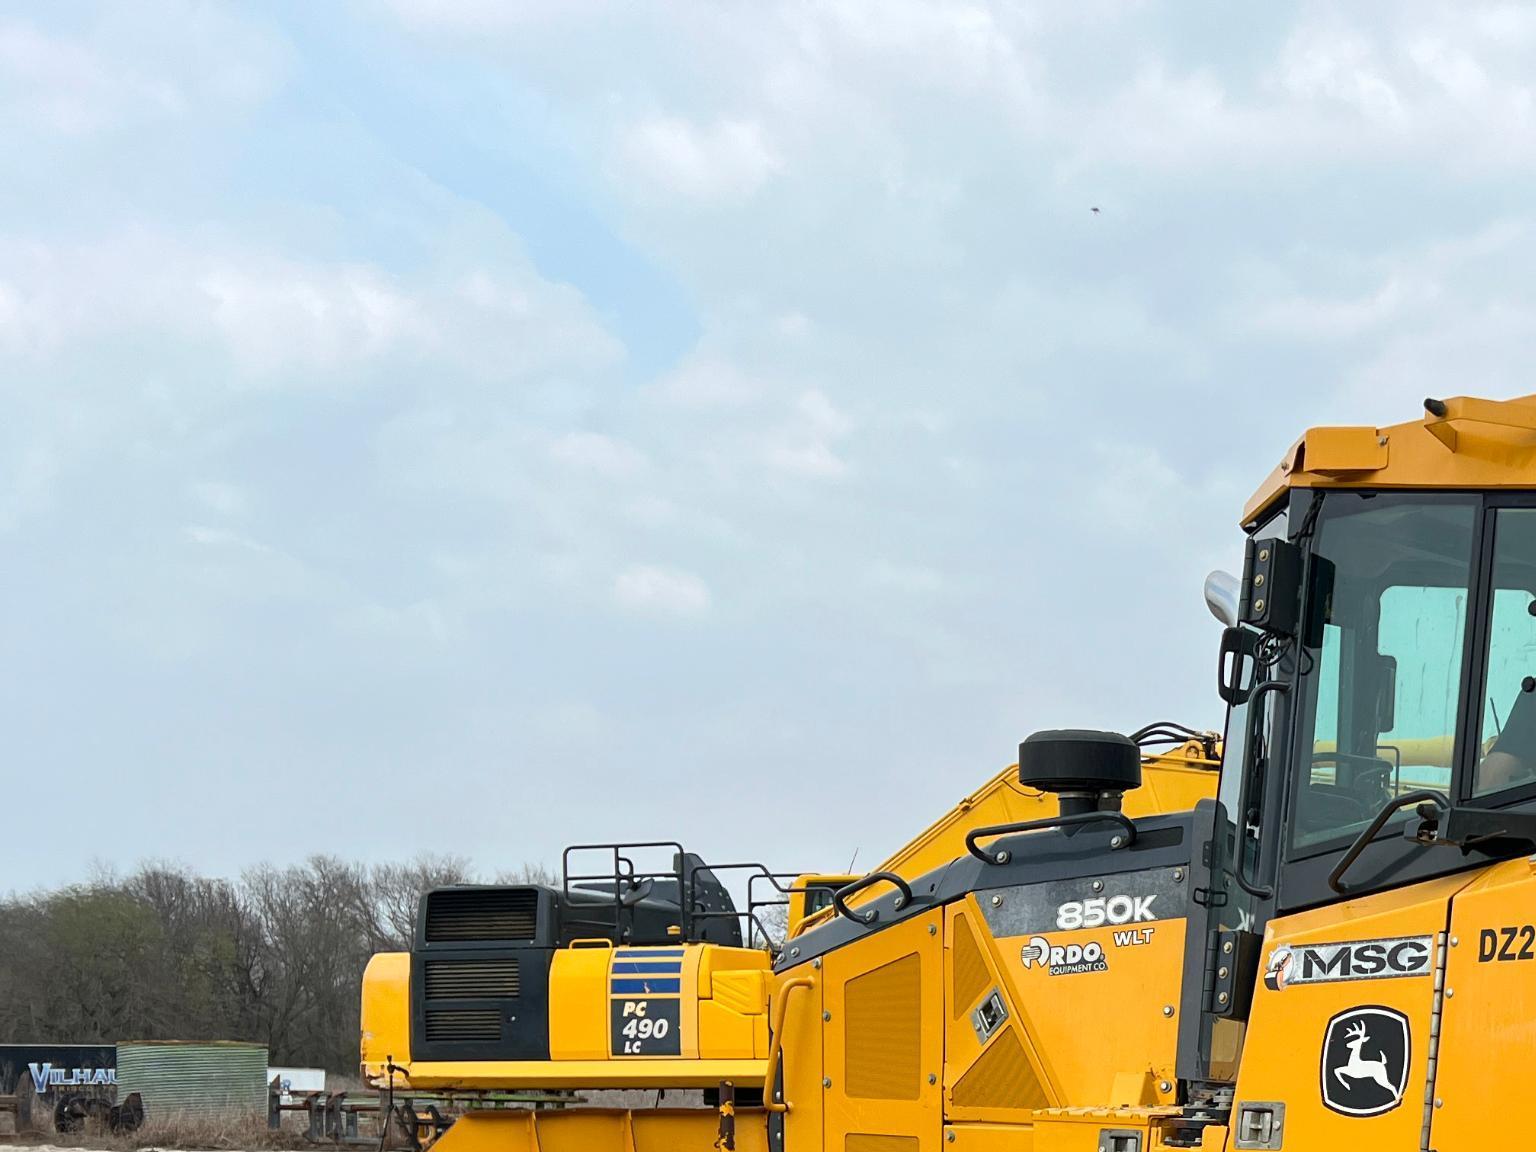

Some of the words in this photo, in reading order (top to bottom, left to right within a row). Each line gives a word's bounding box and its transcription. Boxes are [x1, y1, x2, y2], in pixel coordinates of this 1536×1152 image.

[1056, 894, 1158, 930] 850K
[1113, 927, 1155, 947] WLT
[1049, 963, 1092, 976] EQUIPMENT
[1302, 941, 1429, 979] MSG
[622, 1001, 647, 1017] PC
[622, 1018, 669, 1039] 490
[624, 1040, 642, 1054] LC
